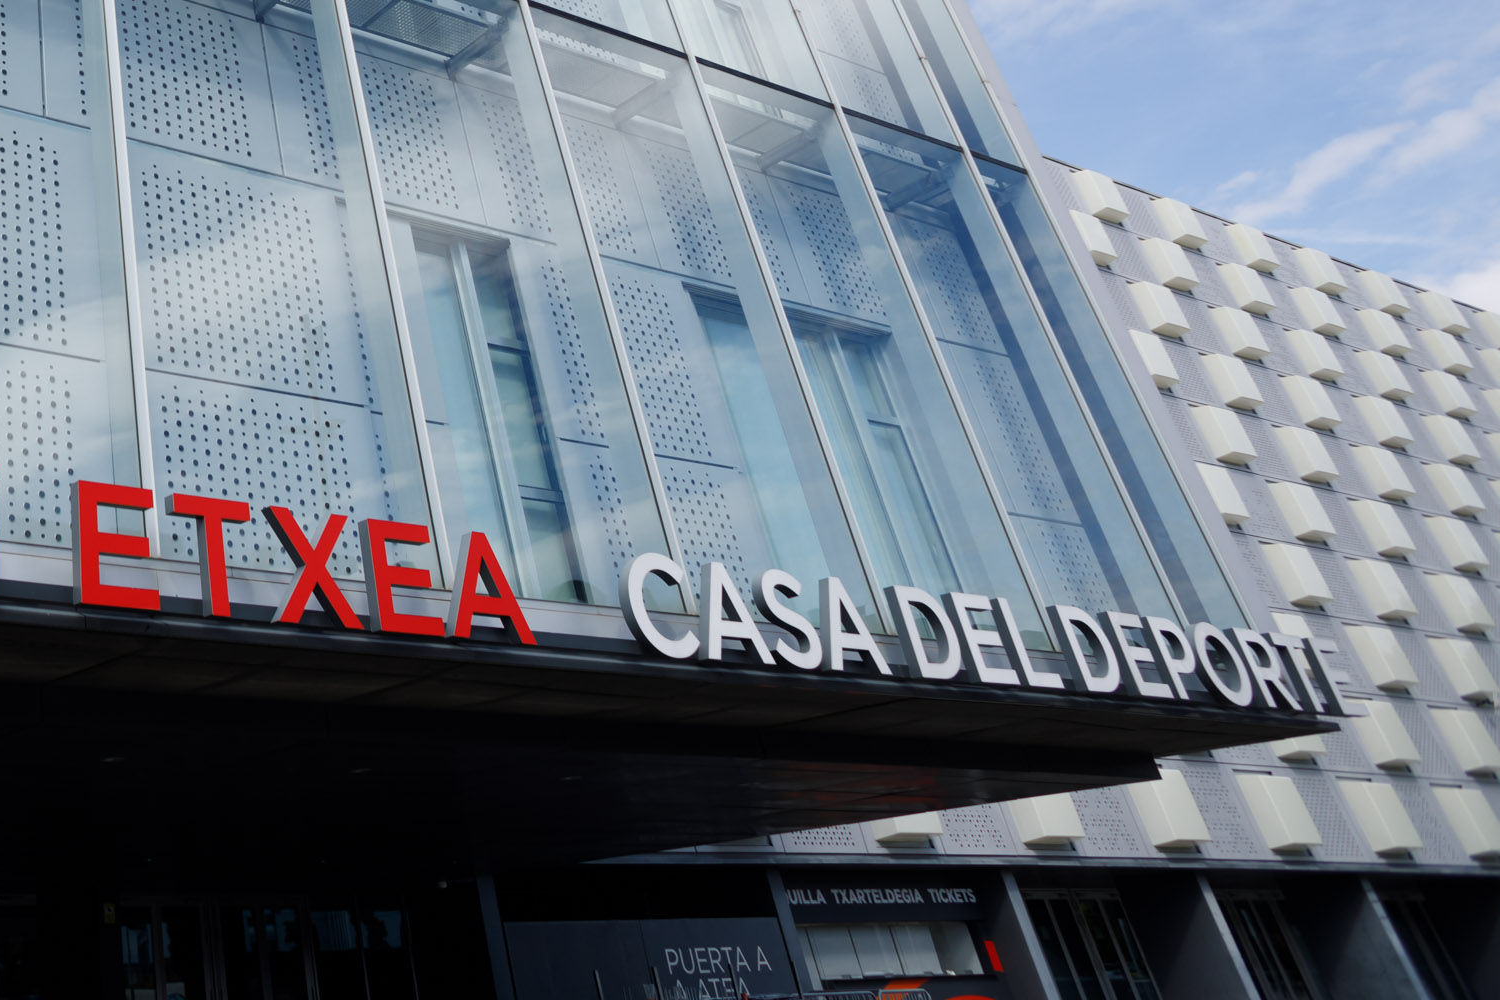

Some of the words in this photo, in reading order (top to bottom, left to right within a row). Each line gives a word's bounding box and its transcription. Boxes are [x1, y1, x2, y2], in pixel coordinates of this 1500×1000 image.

[72, 480, 538, 646] ETXEA
[618, 552, 893, 676] CASA
[884, 585, 1066, 689] DEL
[1046, 604, 1369, 717] DEPORTE
[830, 887, 925, 904] TXARTELDEGIA
[927, 887, 977, 904] TICKETS
[664, 946, 752, 976] PUERTA
[757, 945, 773, 972] A
